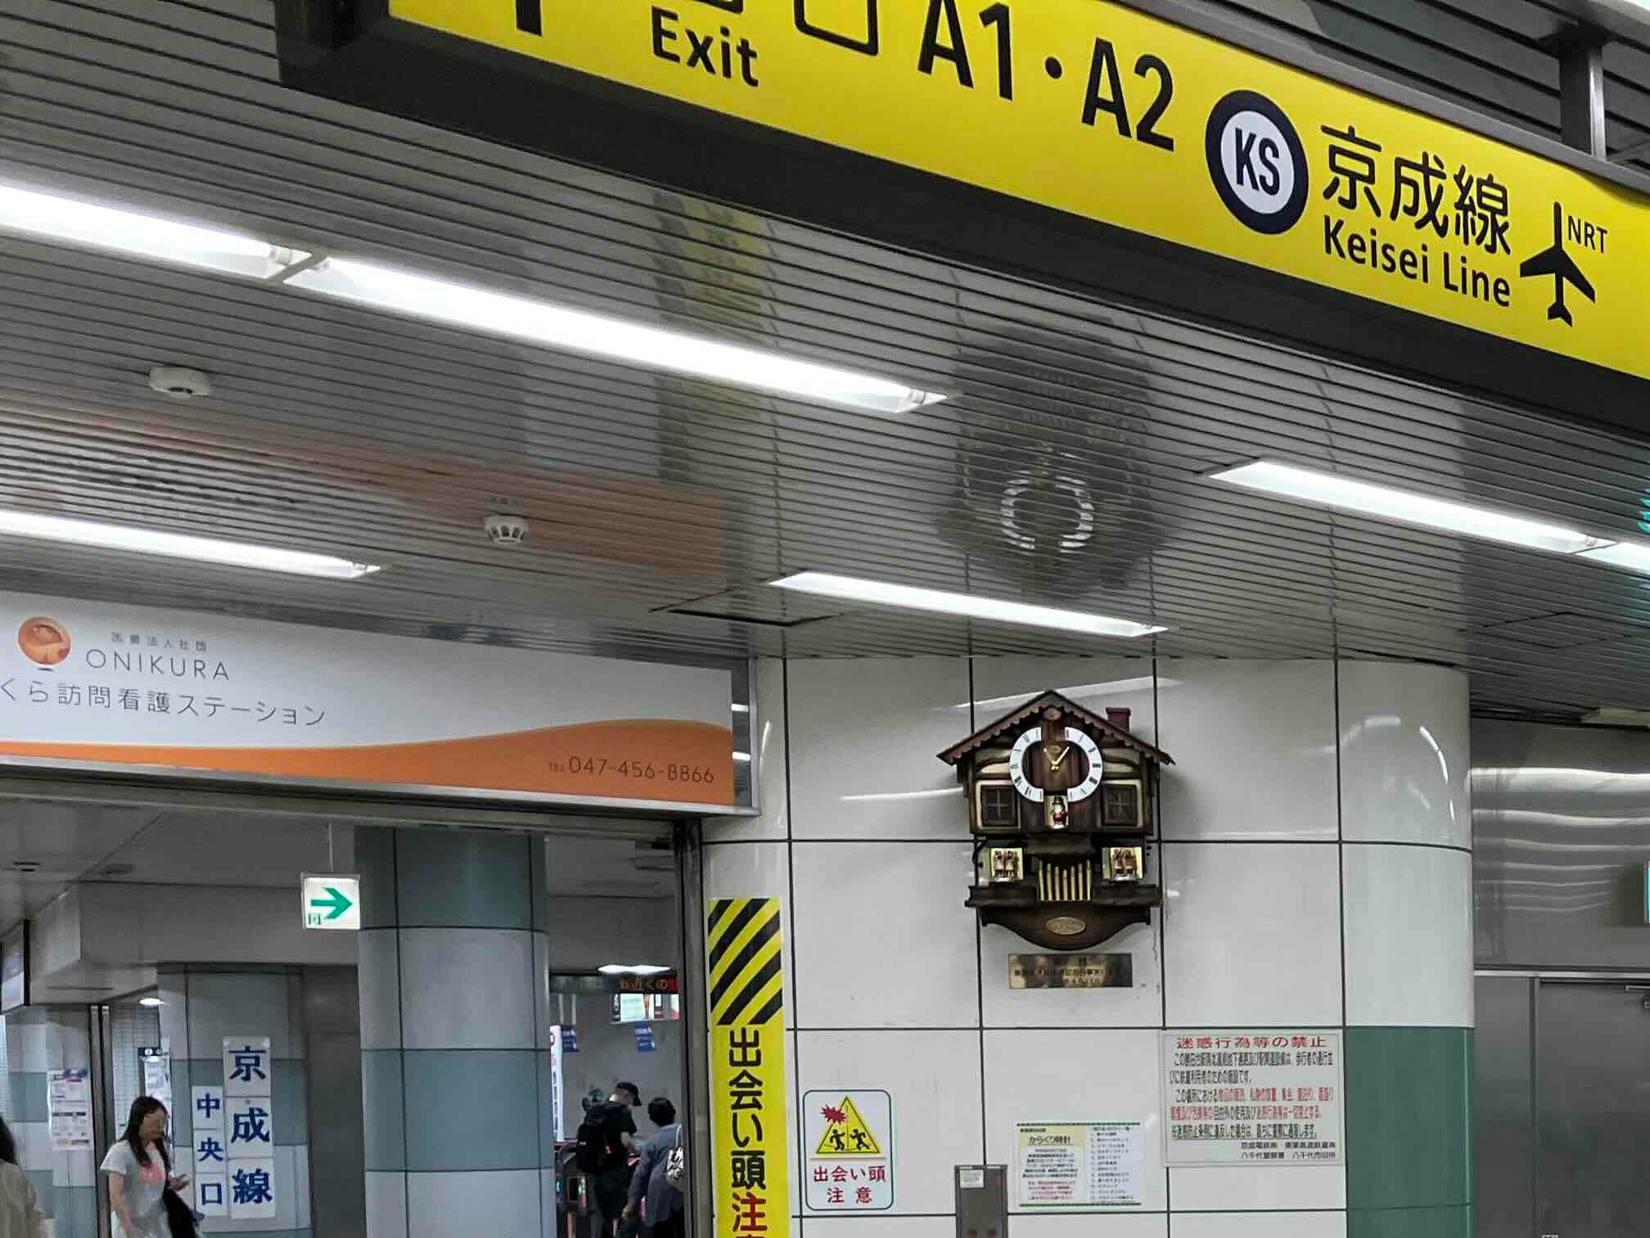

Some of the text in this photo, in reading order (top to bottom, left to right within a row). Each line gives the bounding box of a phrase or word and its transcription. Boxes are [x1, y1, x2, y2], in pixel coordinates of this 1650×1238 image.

[651, 6, 759, 87] Exit
[1234, 127, 1281, 196] KS
[1320, 125, 1512, 256] 京成線
[1567, 215, 1608, 253] NRT
[1323, 215, 1511, 307] Keisei Line
[86, 648, 231, 681] ONIKURA
[1, 676, 326, 727] くら訪問看護ステーション
[569, 756, 716, 785] 047-456-8866
[1176, 1036, 1327, 1049] 迷惑行為等の禁止
[196, 1092, 224, 1206] 中央口
[228, 1046, 273, 1205] 京成線
[813, 1165, 886, 1183] 出会い頭
[826, 1186, 873, 1204] 注意
